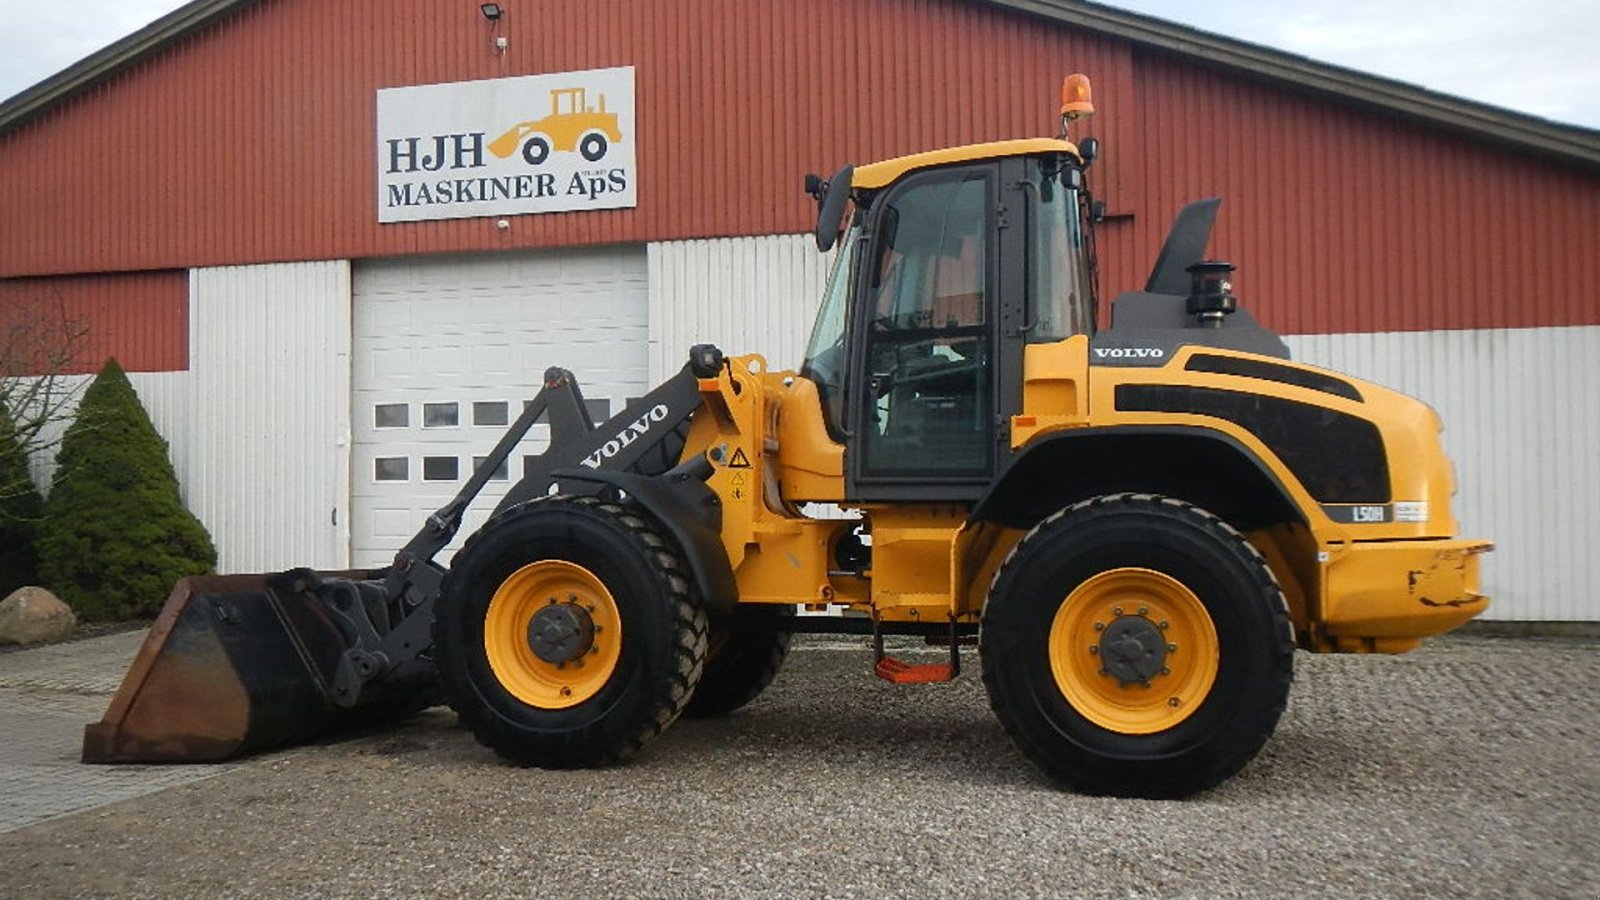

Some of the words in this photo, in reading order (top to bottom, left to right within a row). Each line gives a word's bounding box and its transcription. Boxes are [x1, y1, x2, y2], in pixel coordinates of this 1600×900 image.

[386, 132, 487, 174] HJH
[387, 173, 557, 208] MASKINER
[566, 168, 626, 200] ApS
[1094, 348, 1164, 358] VOLVO
[580, 404, 669, 470] VOLVO
